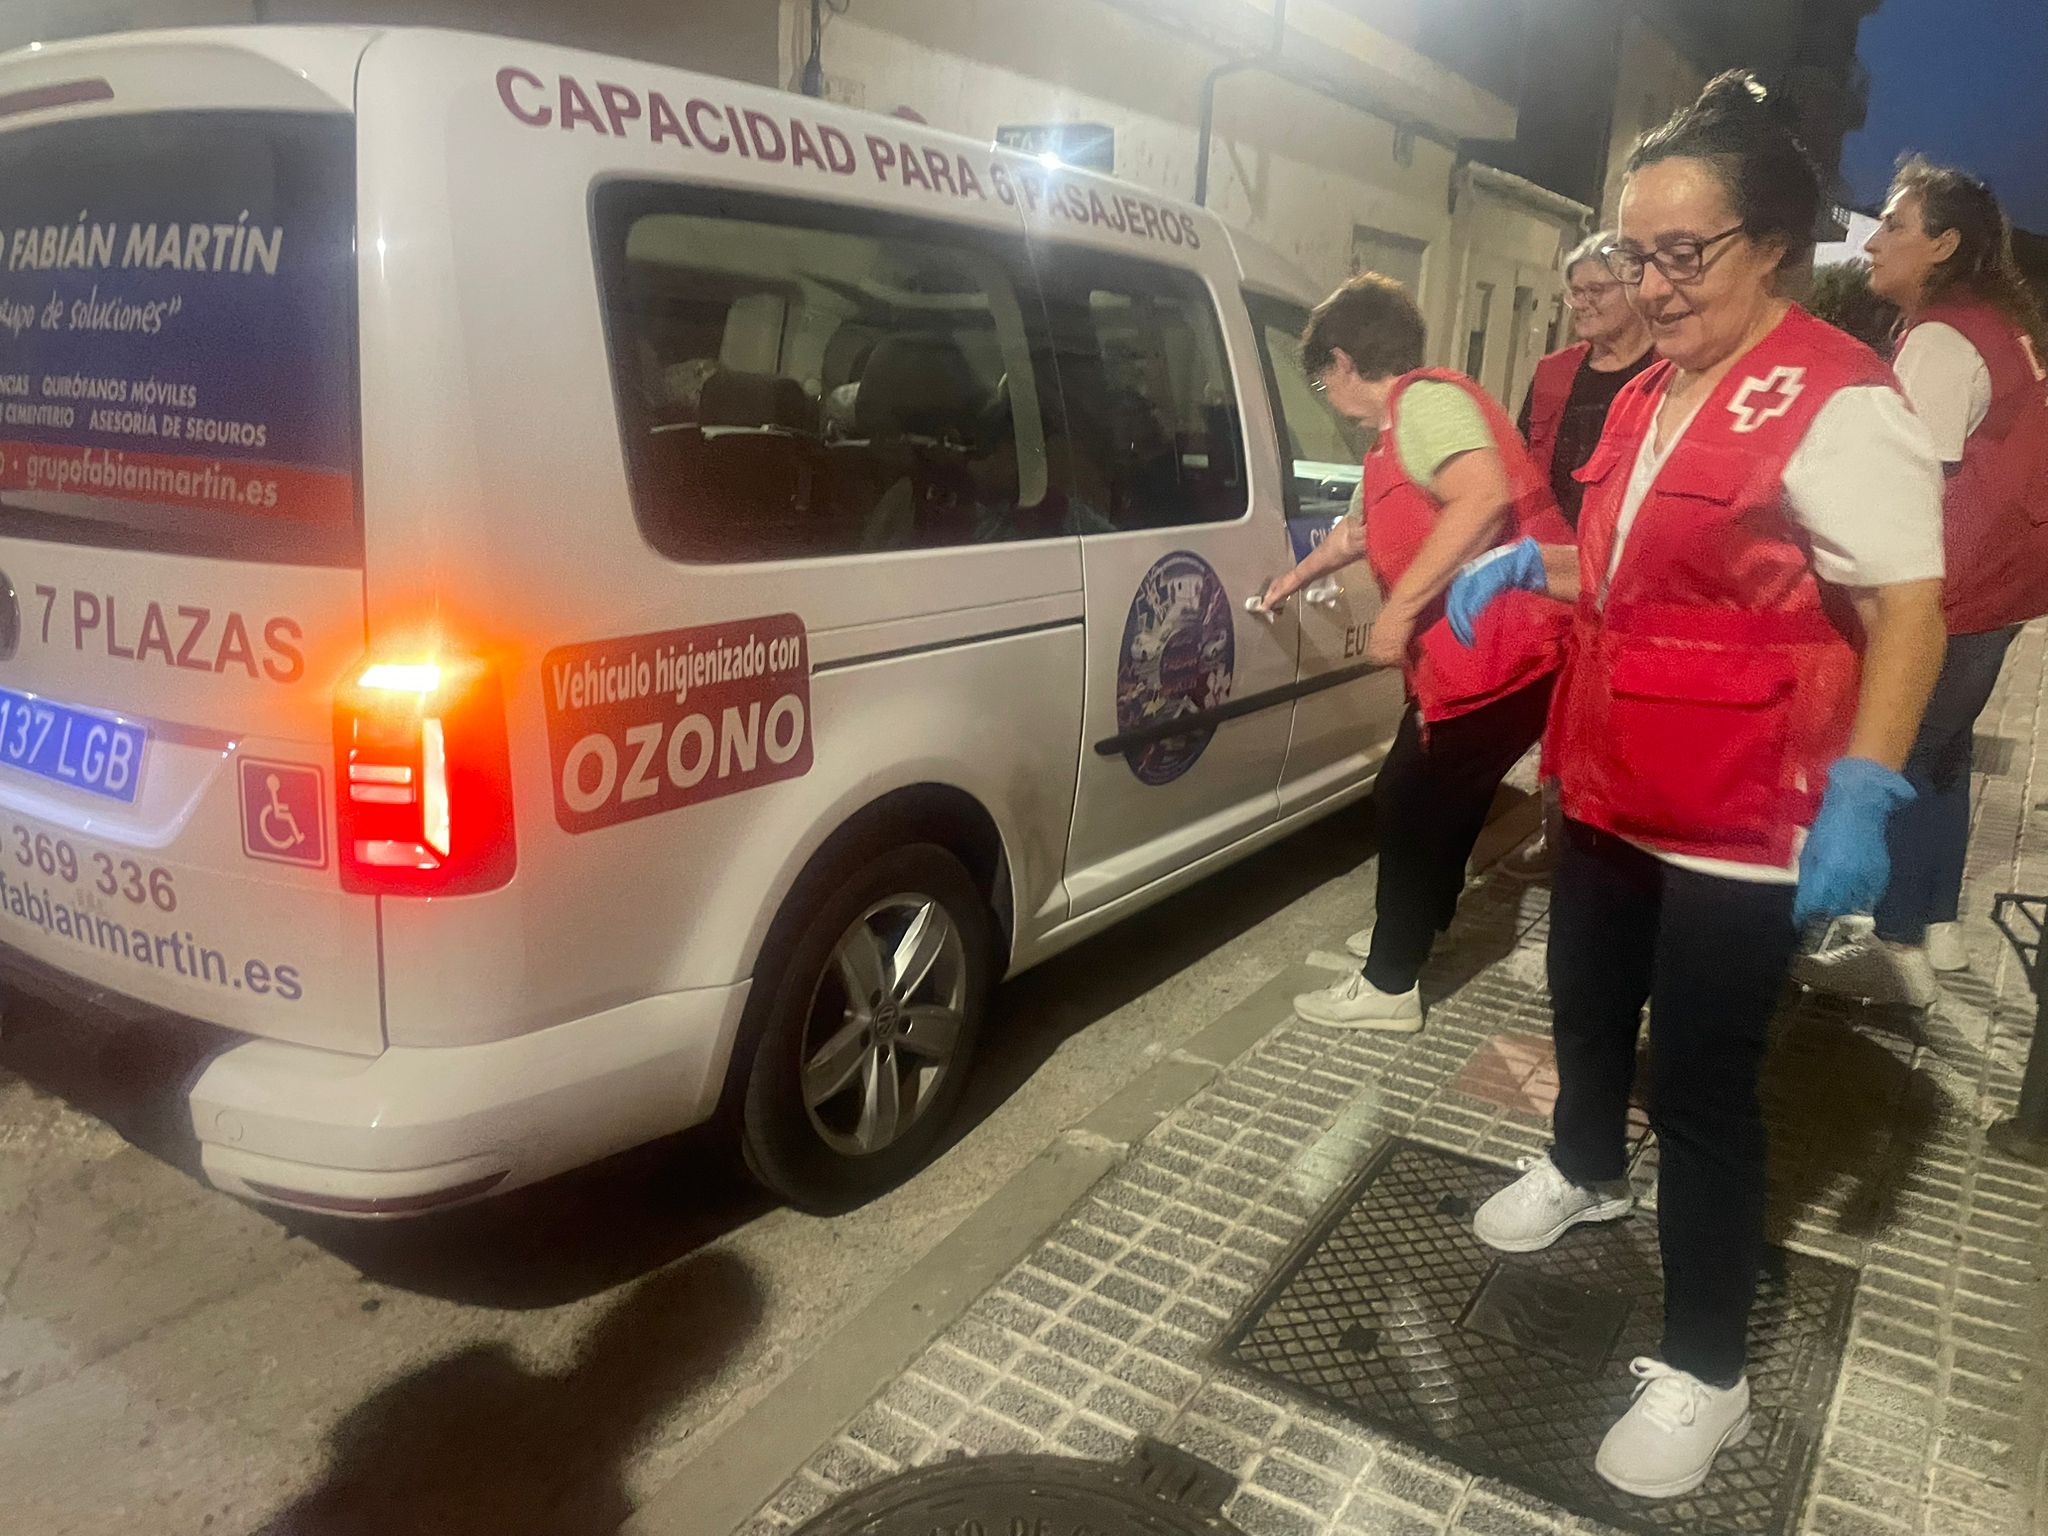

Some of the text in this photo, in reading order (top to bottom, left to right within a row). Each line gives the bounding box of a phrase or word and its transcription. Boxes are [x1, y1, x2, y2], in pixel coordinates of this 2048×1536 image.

[495, 66, 1200, 250] CAPACIDAD PARA 6 PASAJEROS
[9, 208, 117, 272] FABIÁN
[121, 208, 284, 276] MARTÍN
[131, 375, 197, 409] MÓVILES
[162, 414, 181, 438] DE
[185, 418, 267, 447] SEGUROS
[26, 447, 279, 508] grupofabianmartin.es
[35, 584, 305, 684] 7 PLAZAS
[552, 633, 800, 711] Vehículo higienizado con
[56, 717, 134, 793] LGB
[562, 693, 805, 813] OZONO
[12, 825, 178, 913] 369 336
